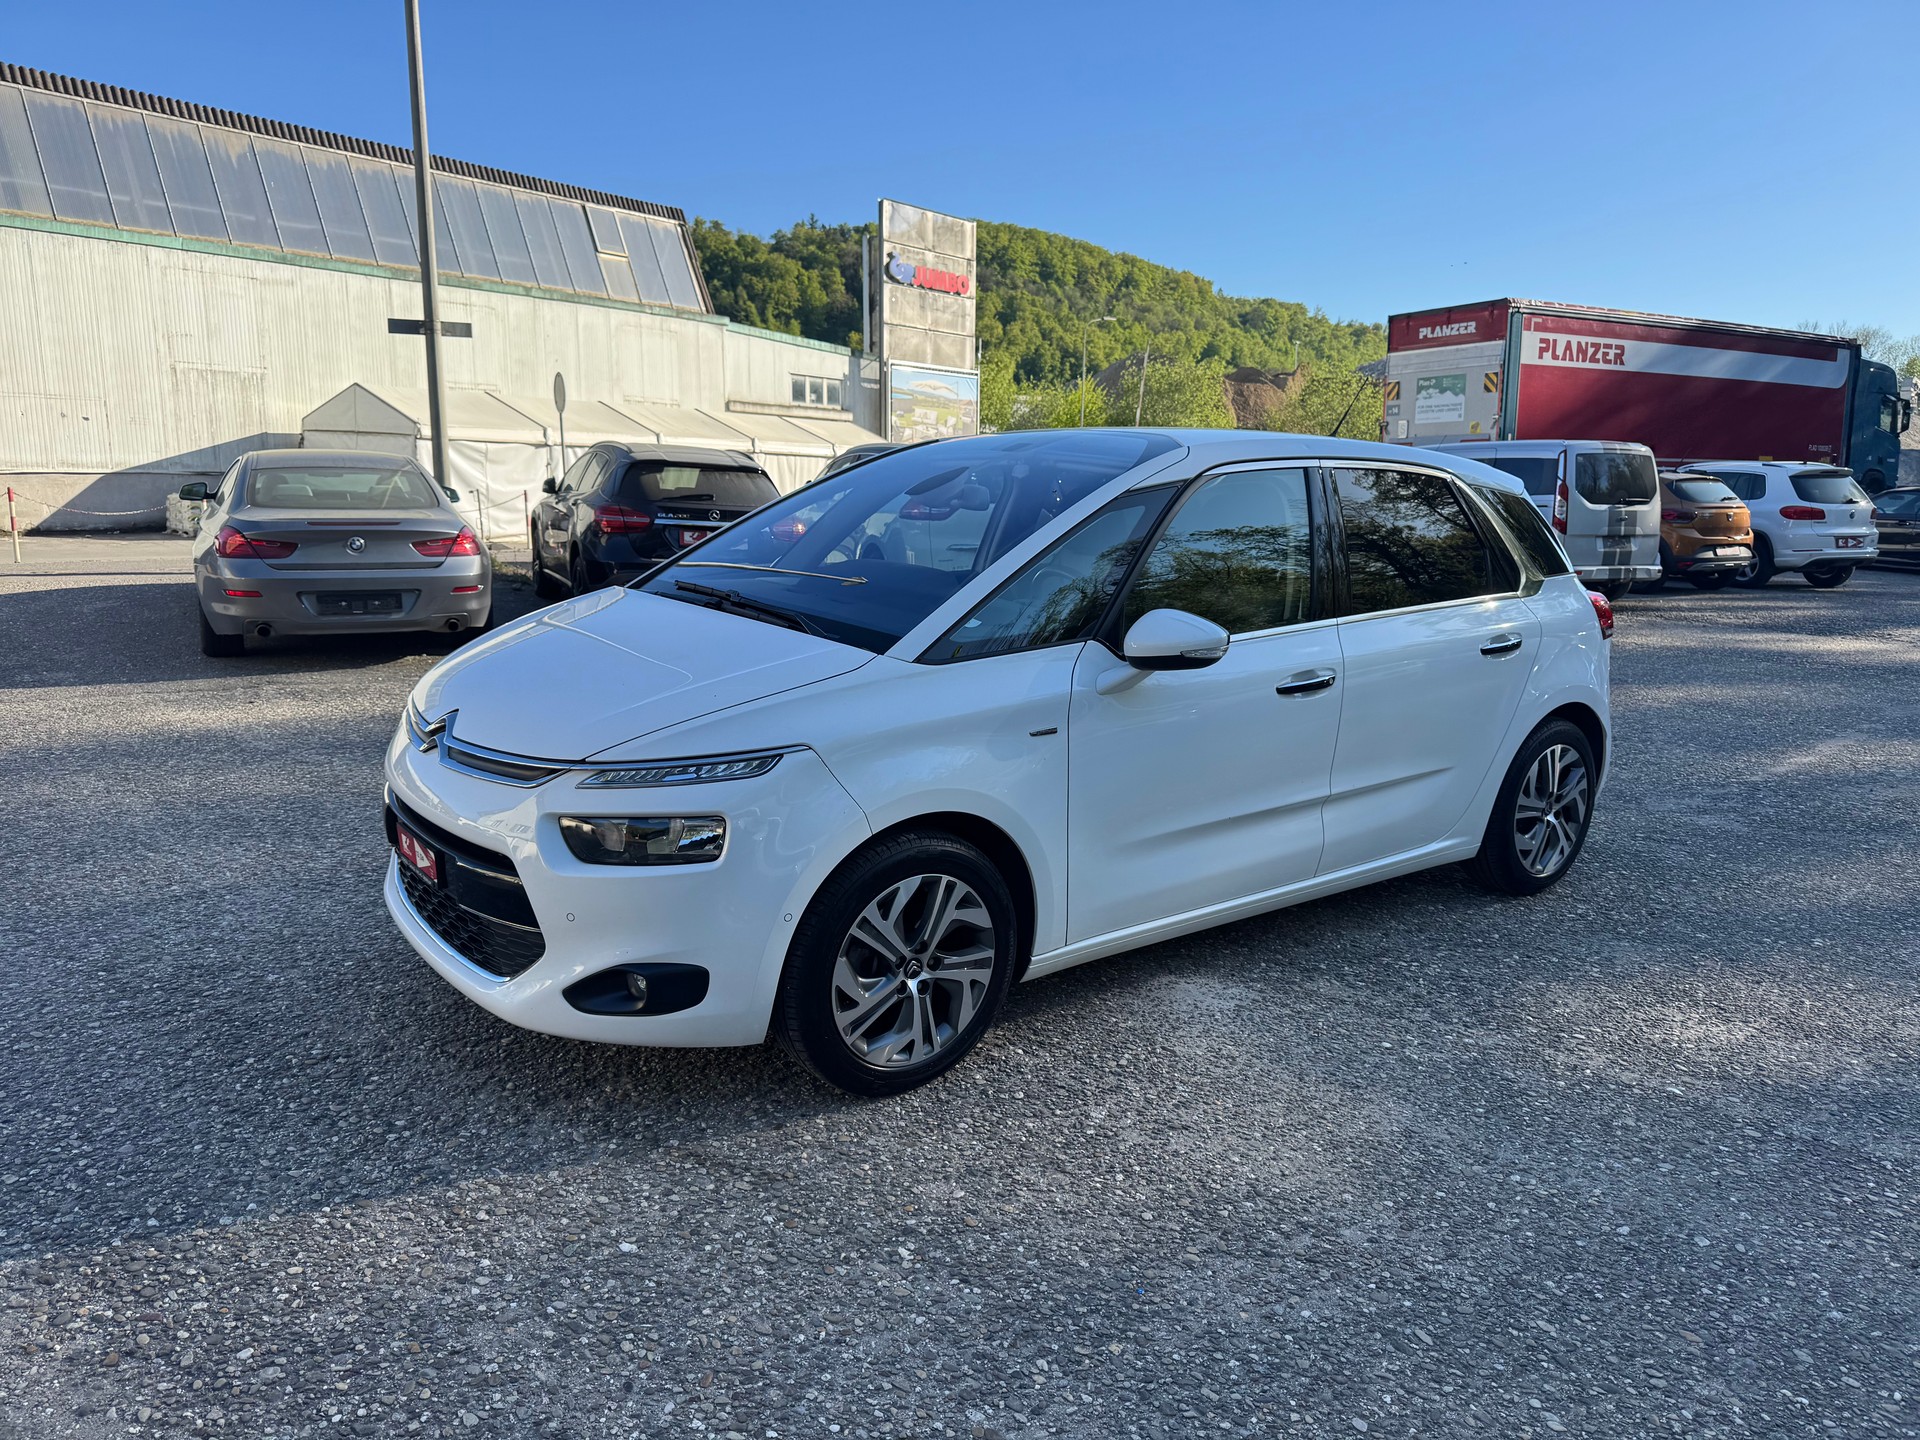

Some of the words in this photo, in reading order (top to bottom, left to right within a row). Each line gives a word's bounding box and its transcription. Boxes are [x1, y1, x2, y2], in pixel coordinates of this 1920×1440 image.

[912, 265, 970, 295] JUMBO
[1418, 321, 1477, 339] PLANZER
[1537, 337, 1626, 366] PLANZER
